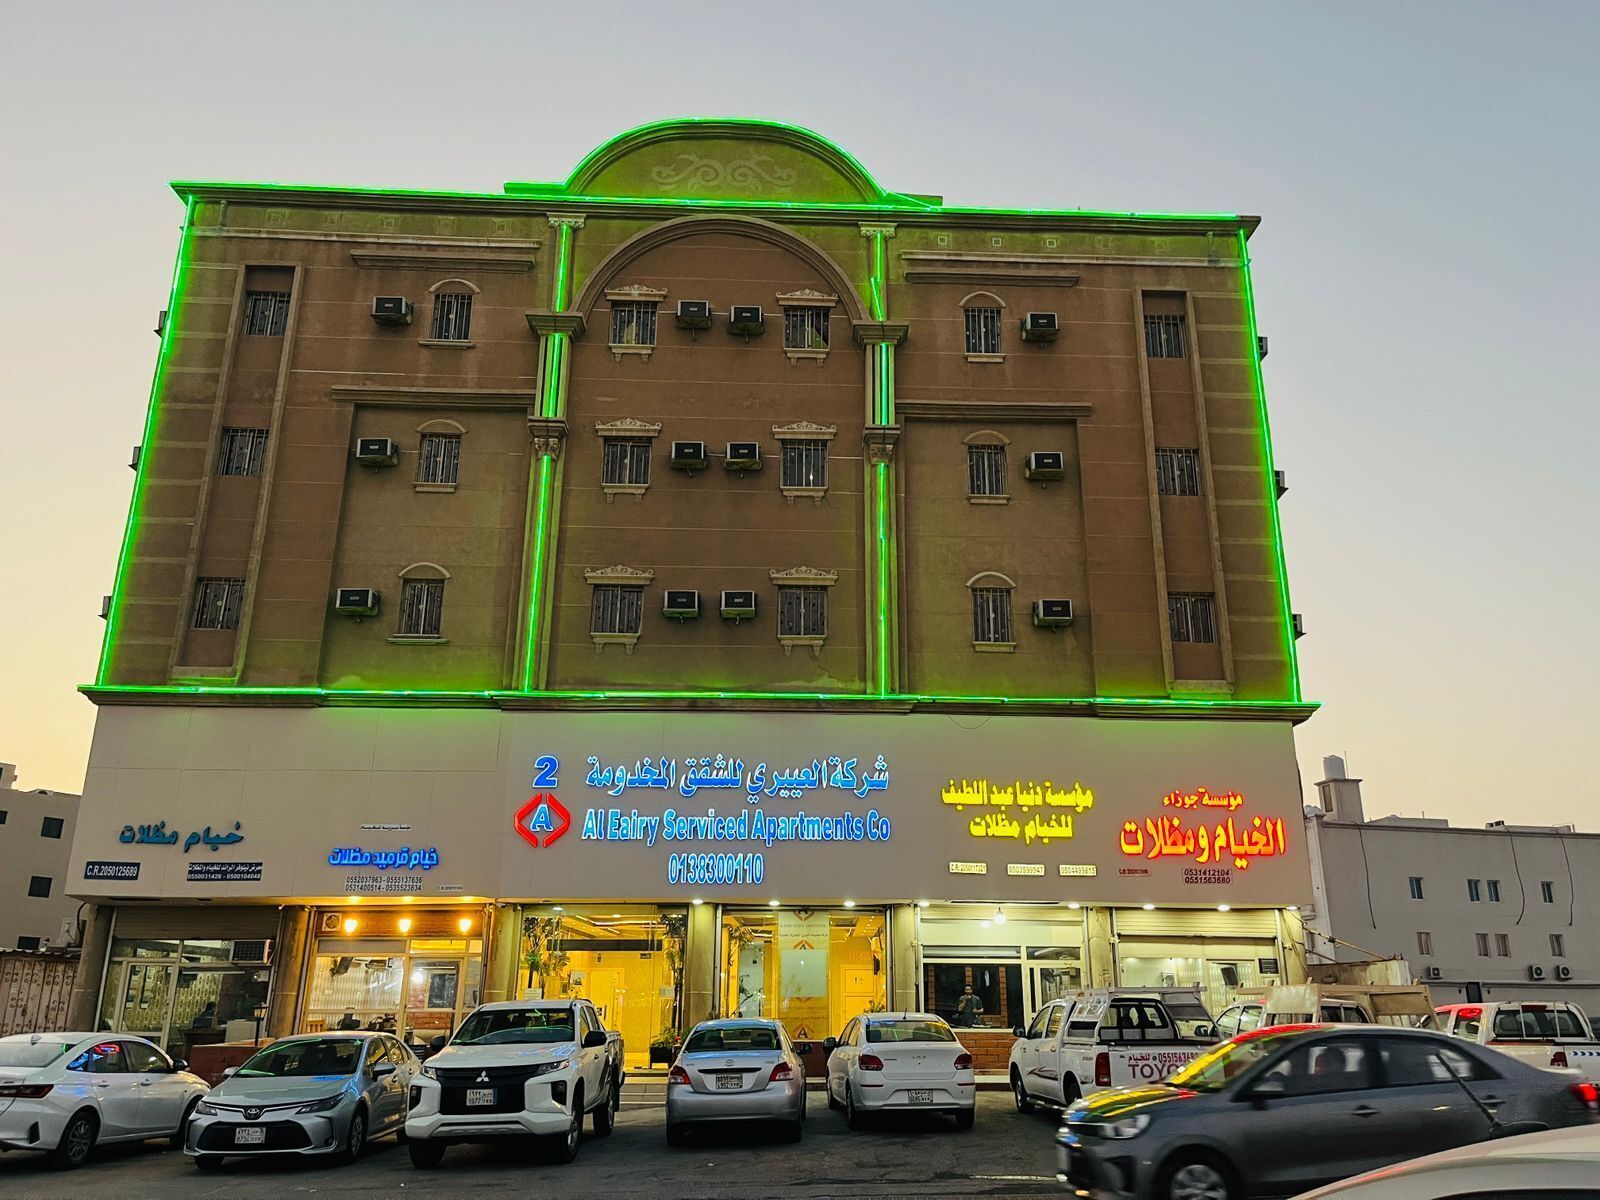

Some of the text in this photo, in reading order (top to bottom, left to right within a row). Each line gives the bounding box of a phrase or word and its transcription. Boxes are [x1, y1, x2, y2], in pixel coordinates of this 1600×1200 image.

[531, 755, 559, 788] 2
[585, 753, 889, 804] شركة العييري للشقق المخدومة
[941, 779, 988, 811] اللطيف
[990, 784, 1014, 811] عبد
[1045, 781, 1094, 812] مؤسسة
[1162, 786, 1243, 811] مؤسسة جوزاء
[530, 804, 553, 832] A
[582, 807, 891, 847] Al Eairy Serviced Apartments Co
[969, 813, 1073, 845] للخيام مظلات
[119, 820, 244, 853] خيام مظلات
[1119, 815, 1285, 869] الخيام ومظلات
[329, 847, 439, 870] خيام قرميد مظلات
[668, 853, 763, 885] 0138300110
